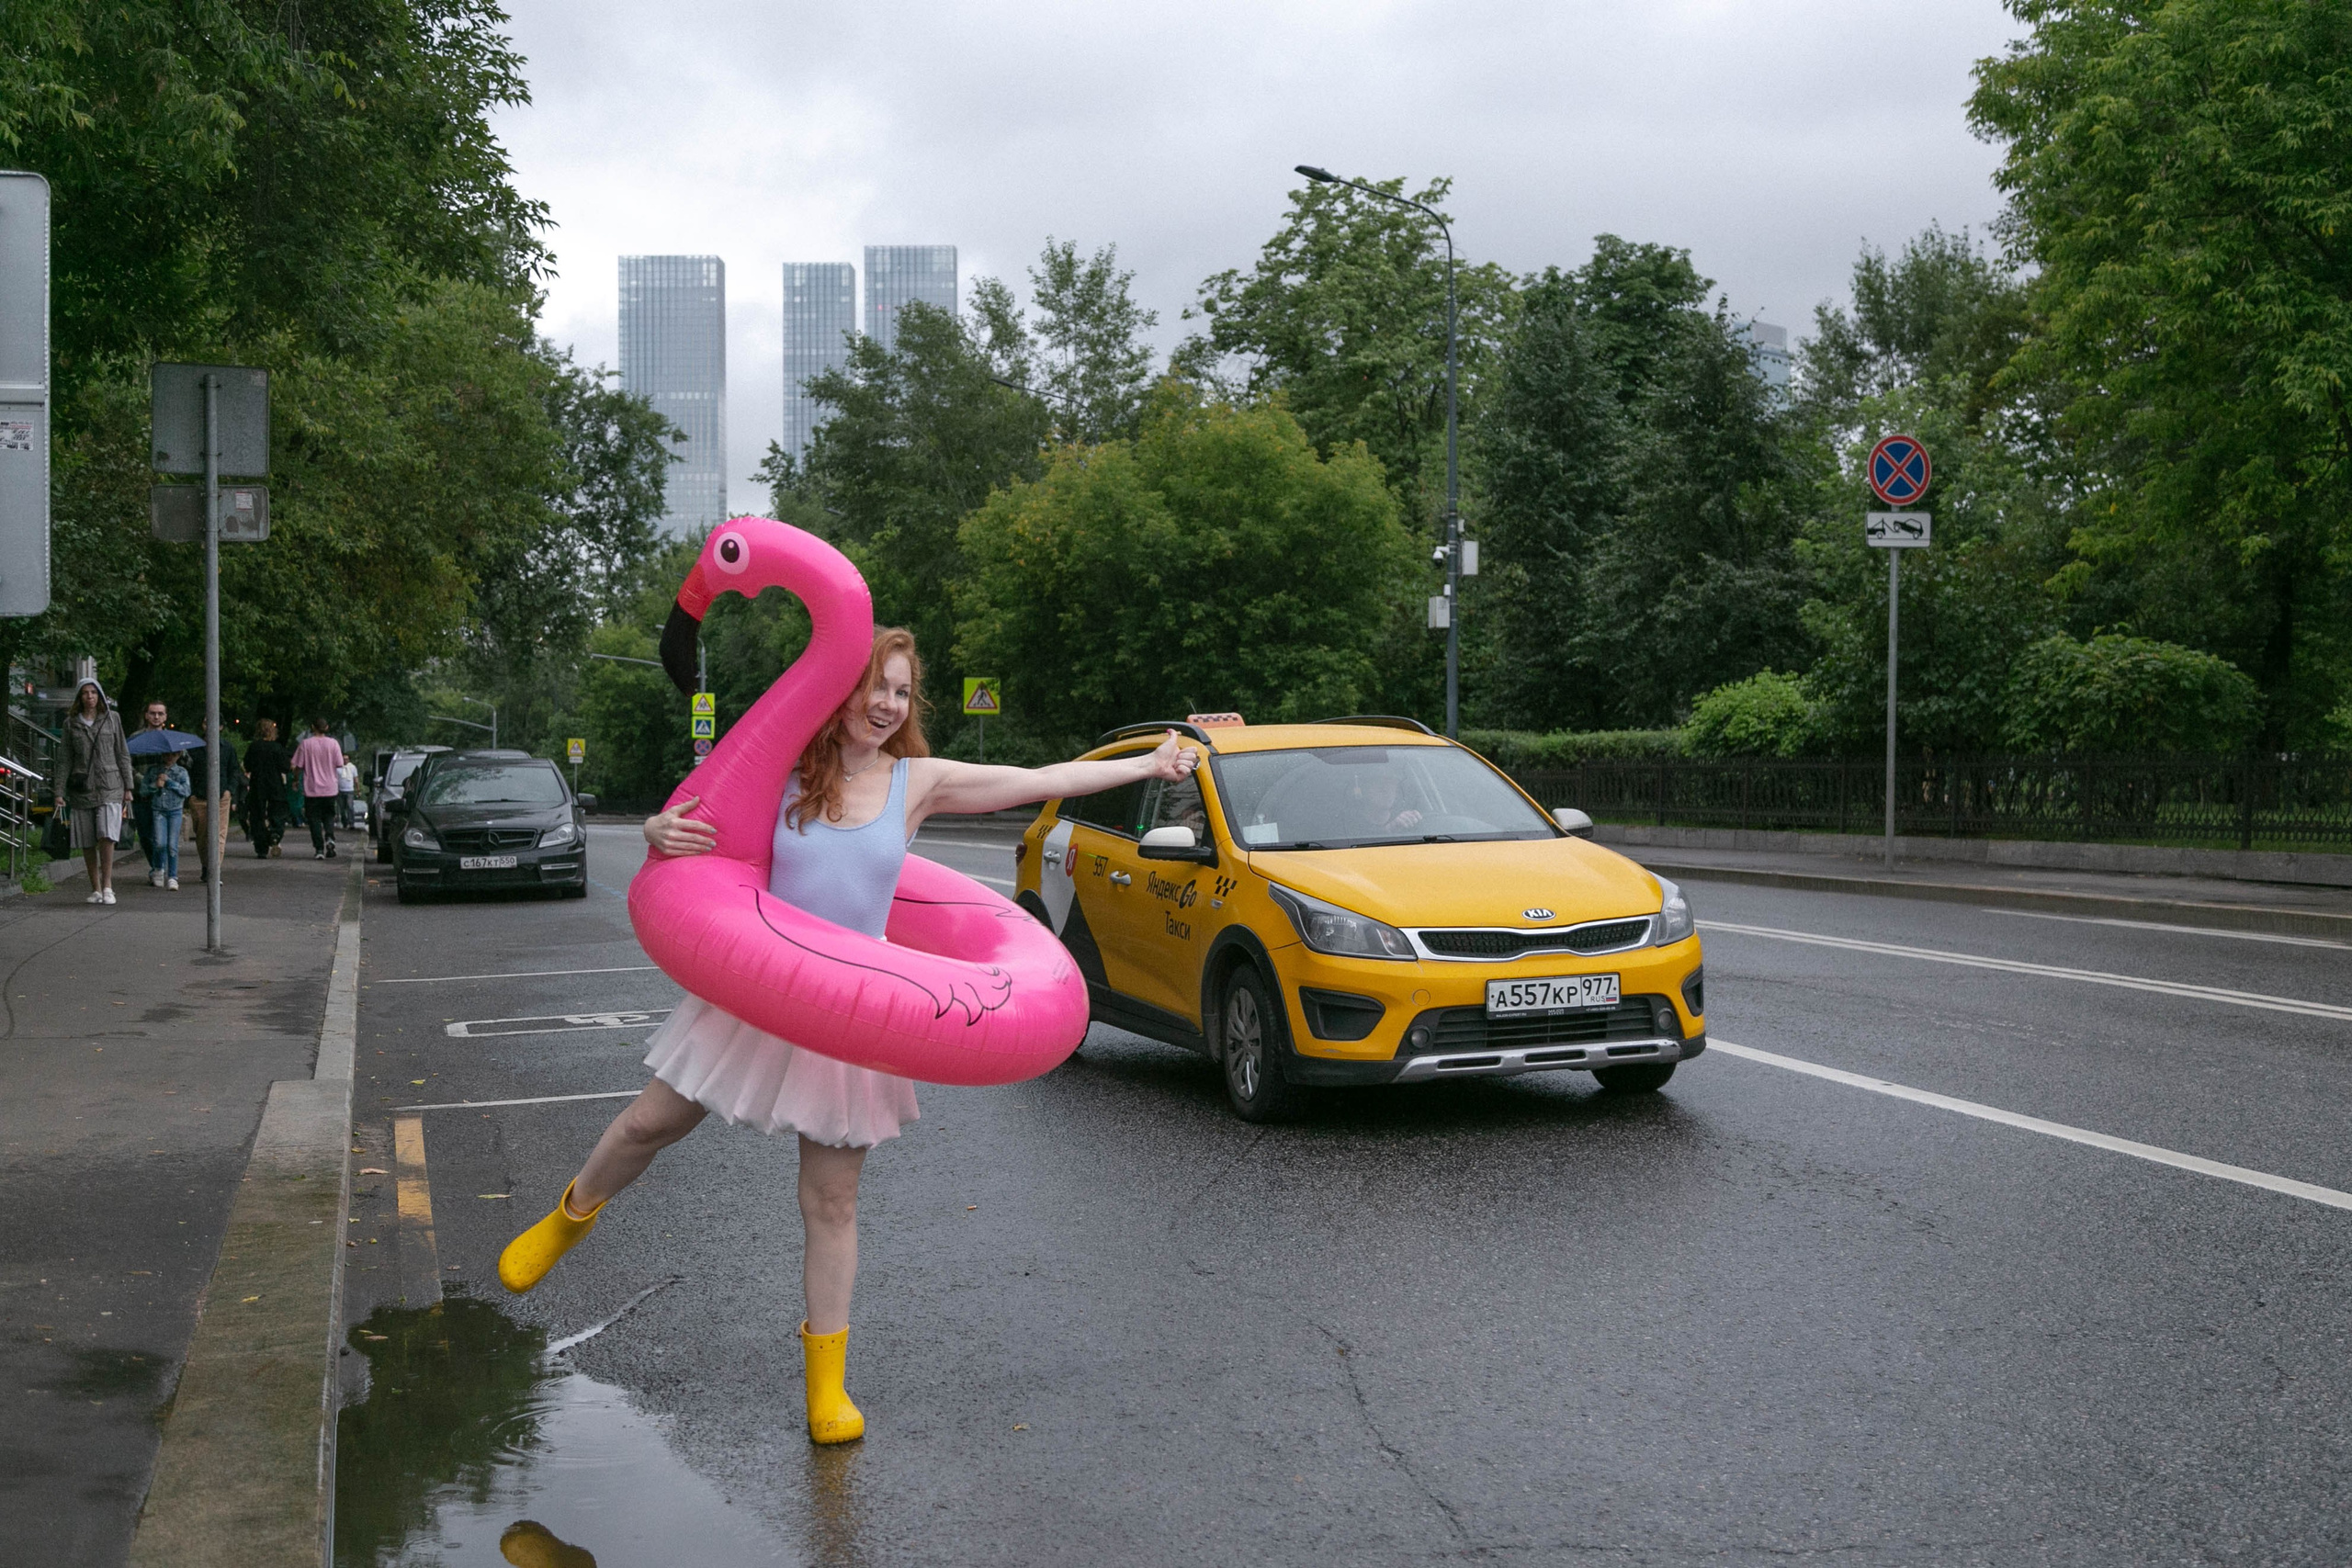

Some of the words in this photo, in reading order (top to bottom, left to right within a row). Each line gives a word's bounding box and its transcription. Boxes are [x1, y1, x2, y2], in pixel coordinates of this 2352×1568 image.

[501, 856, 515, 864] 550
[1092, 854, 1109, 877] 557
[1146, 871, 1182, 903] Яндекс
[1179, 879, 1197, 909] Go
[1527, 908, 1553, 918] KIA
[1165, 910, 1191, 942] Такси
[1582, 976, 1612, 997] 977
[1590, 995, 1606, 1003] RUS
